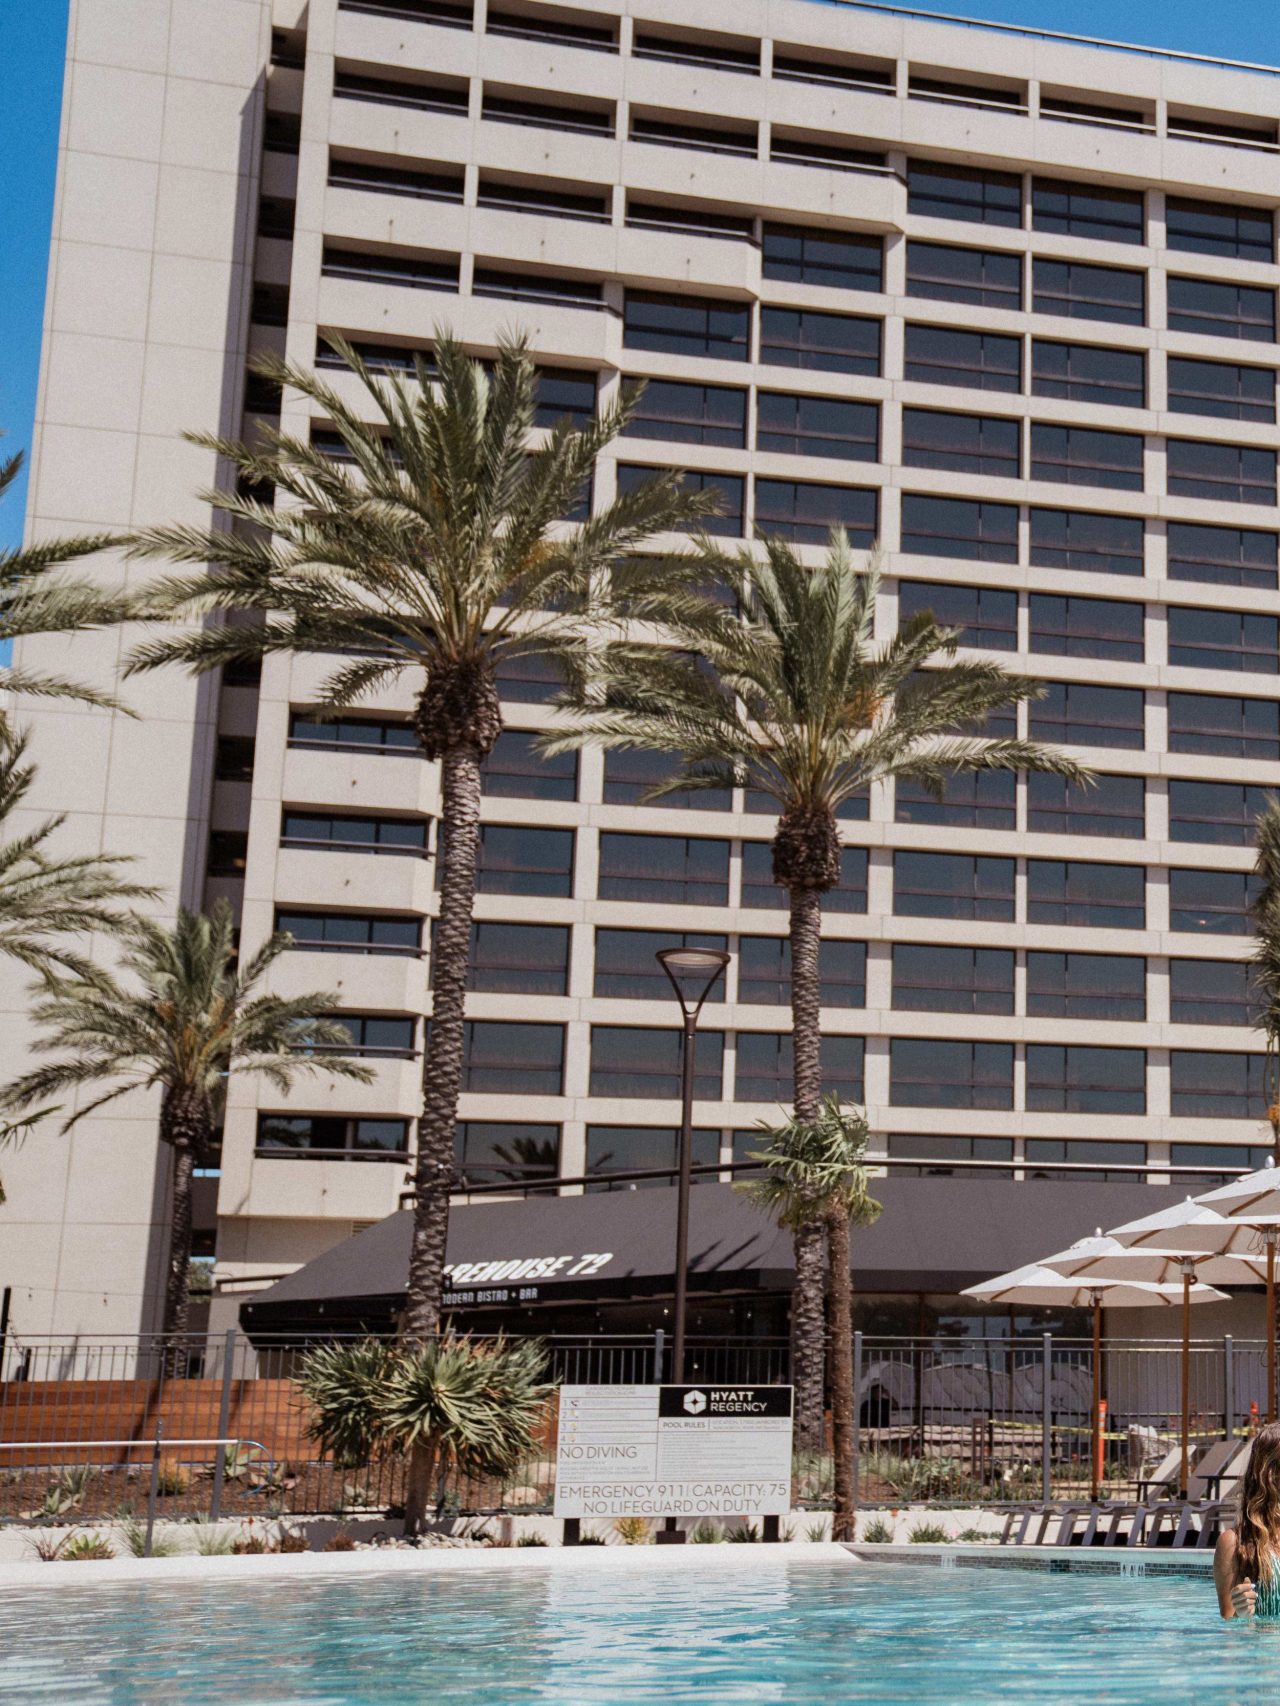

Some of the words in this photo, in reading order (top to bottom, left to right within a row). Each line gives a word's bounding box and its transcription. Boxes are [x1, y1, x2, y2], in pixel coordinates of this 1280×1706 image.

[566, 1252, 614, 1276] 72
[477, 1289, 508, 1302] BISTRO
[519, 1287, 538, 1300] BAR
[710, 1391, 755, 1401] HYATT
[710, 1402, 768, 1412] REGENCY
[662, 1421, 682, 1429] POOL
[684, 1421, 706, 1429] RULES
[560, 1446, 584, 1459] NO
[586, 1446, 638, 1459] DIVING
[560, 1485, 655, 1498] EMERGENCY
[658, 1484, 684, 1497] 911
[692, 1483, 766, 1497] CAPACITY:
[769, 1483, 787, 1496] 75
[583, 1501, 608, 1514] NO
[611, 1500, 693, 1513] LIFEGUARD
[696, 1499, 719, 1512] ON
[723, 1499, 762, 1512] DUTY
